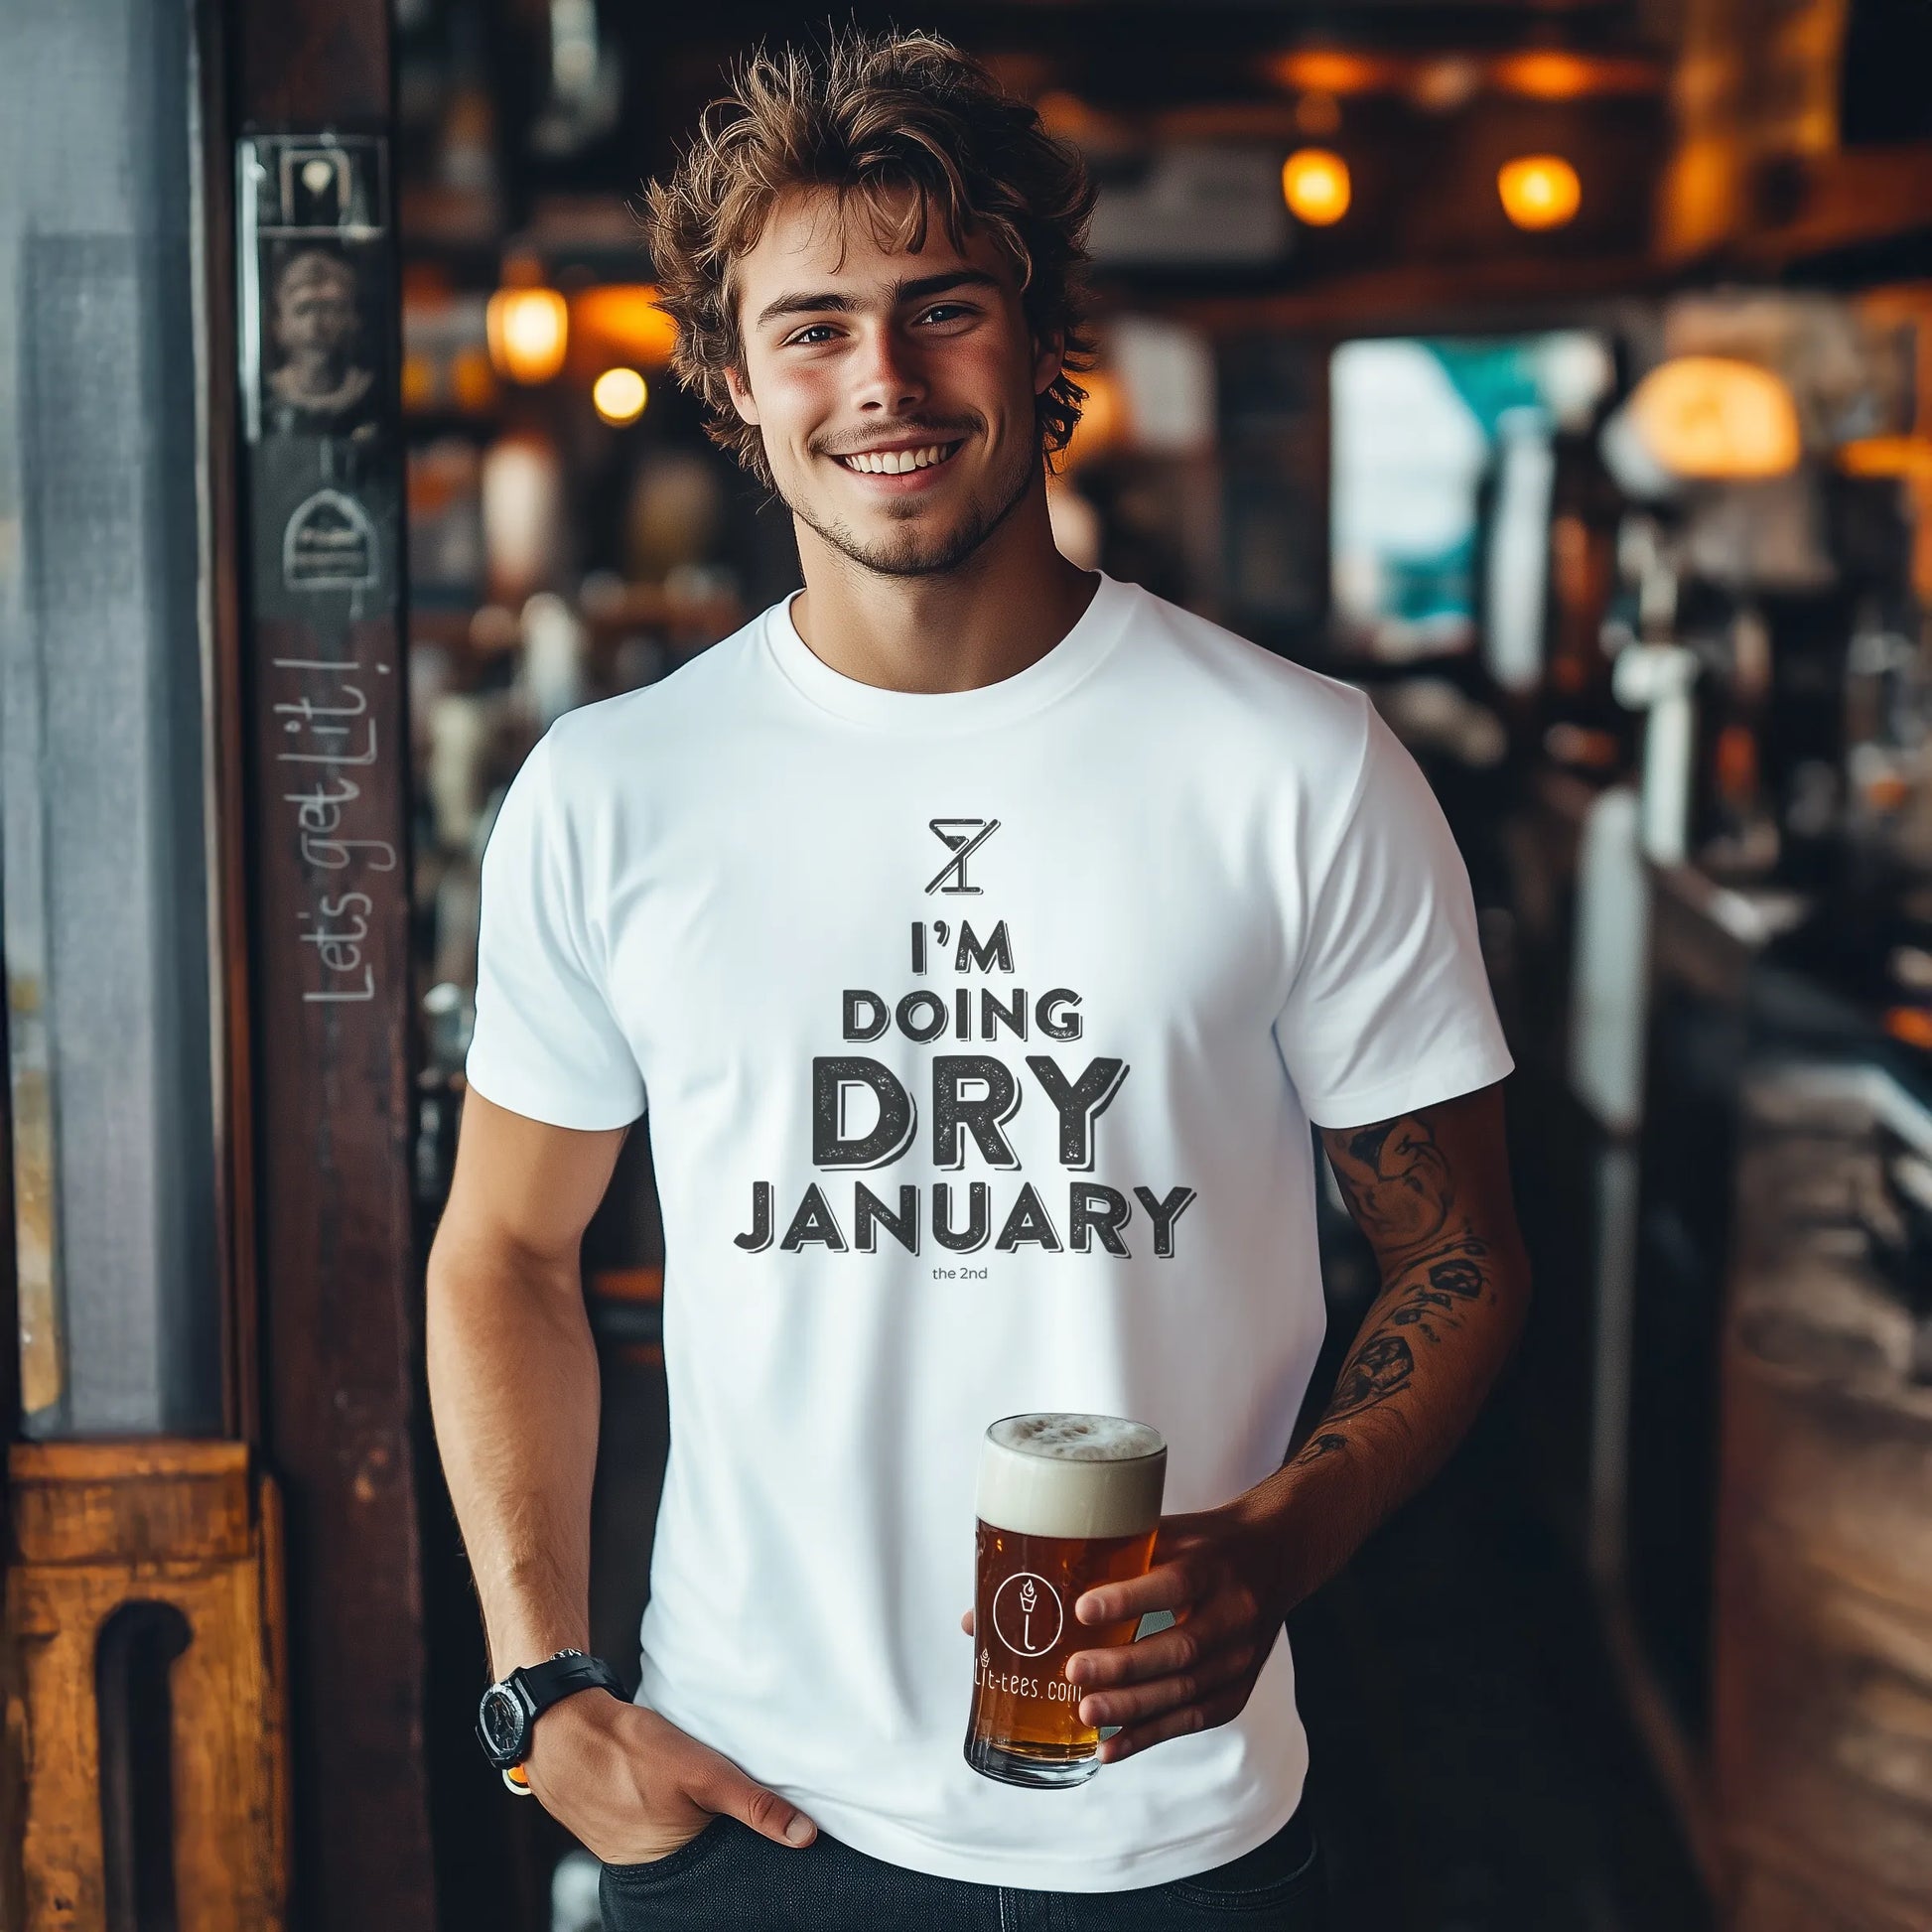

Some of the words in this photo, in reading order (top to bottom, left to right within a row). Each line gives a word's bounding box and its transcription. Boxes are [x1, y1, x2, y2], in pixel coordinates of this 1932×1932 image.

[273, 658, 390, 765] Lit!
[284, 777, 396, 872] get
[298, 892, 374, 1002] Let's
[910, 919, 1016, 977] I'M
[842, 988, 1084, 1044] DOING
[812, 1054, 1131, 1173] DRY
[733, 1180, 1198, 1260] JANUARY
[932, 1267, 956, 1280] the
[959, 1267, 988, 1280] 2nd
